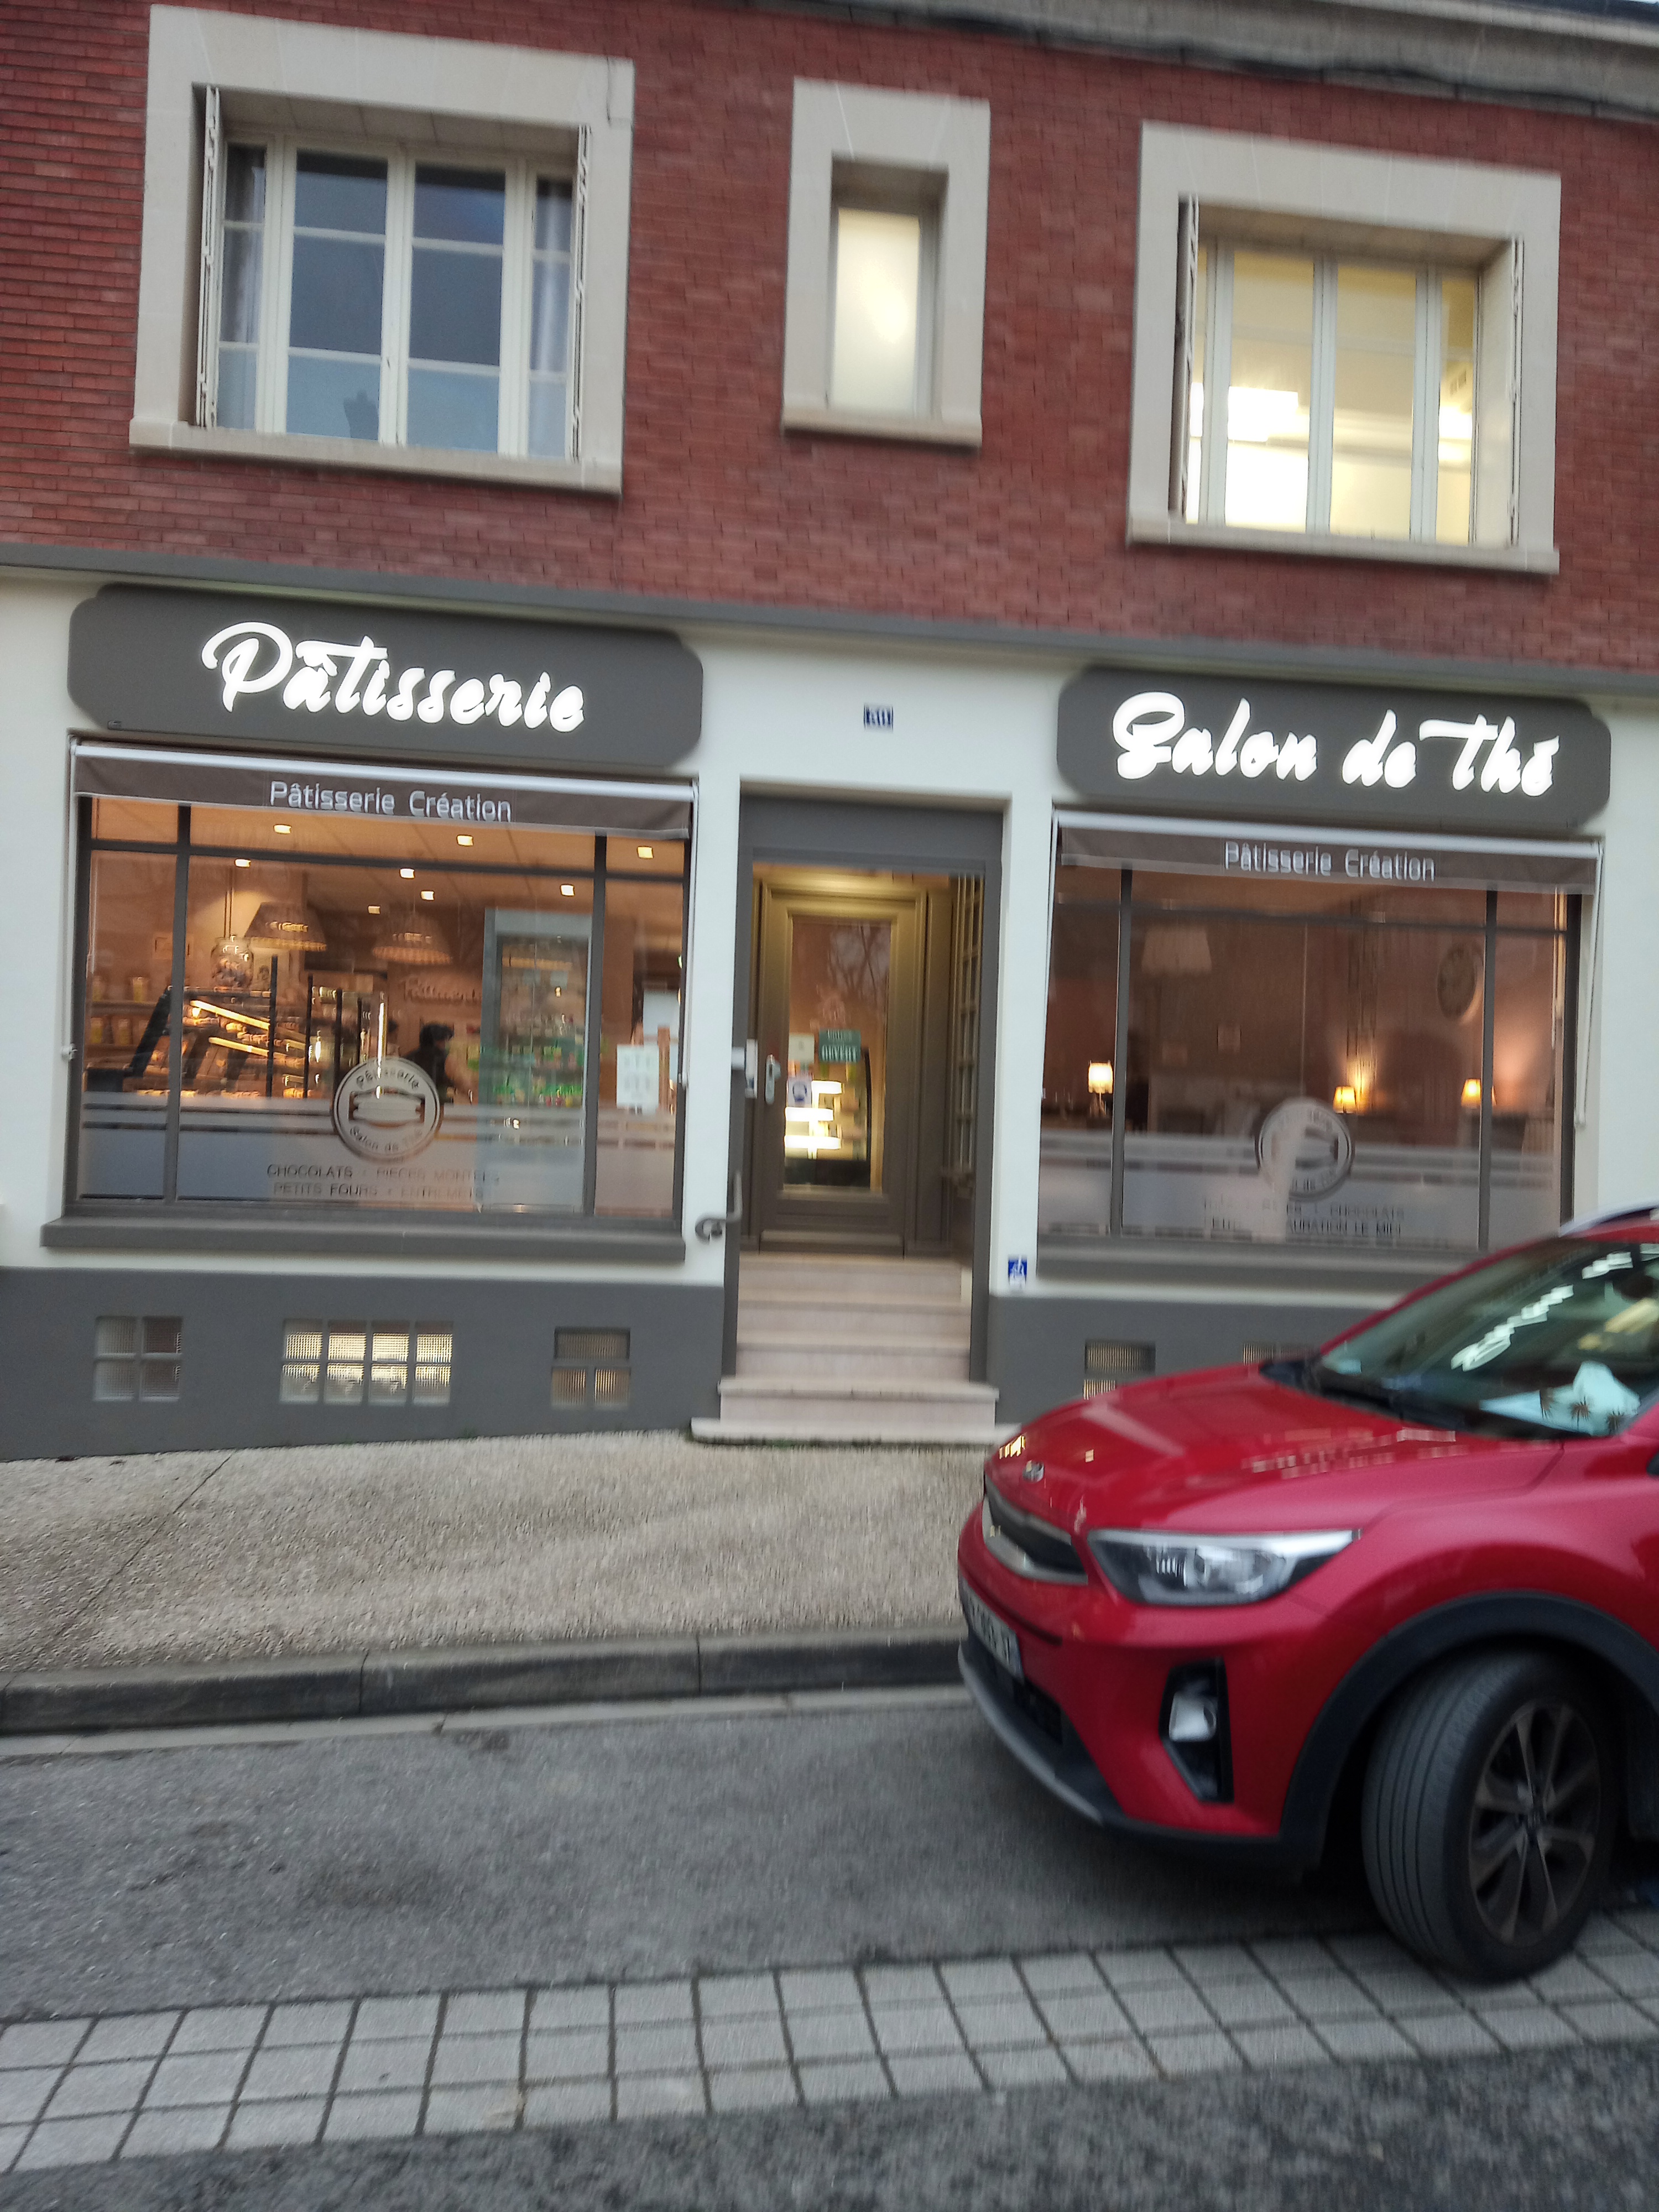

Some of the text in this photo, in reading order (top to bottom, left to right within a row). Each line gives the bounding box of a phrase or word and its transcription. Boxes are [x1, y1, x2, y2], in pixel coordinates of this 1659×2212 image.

[202, 622, 585, 733] Pâtisserie
[1113, 691, 1318, 780] Salon
[1342, 709, 1416, 789] de
[270, 780, 512, 822] Pâtisserie Création
[1224, 841, 1436, 881] Pâtisserie Création
[267, 1164, 353, 1180] CHOCOLATS
